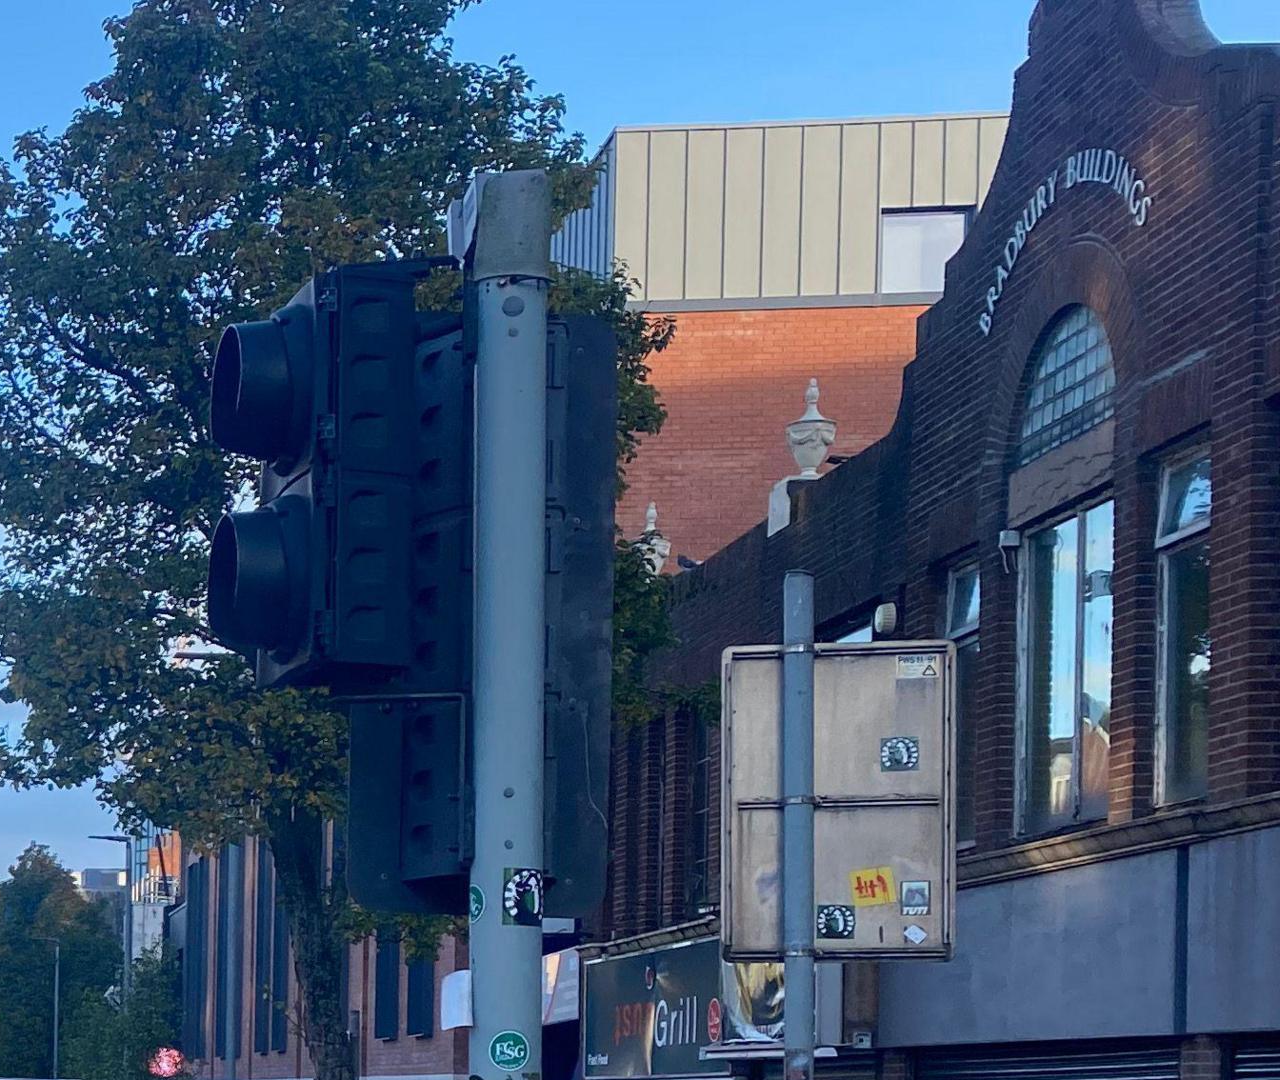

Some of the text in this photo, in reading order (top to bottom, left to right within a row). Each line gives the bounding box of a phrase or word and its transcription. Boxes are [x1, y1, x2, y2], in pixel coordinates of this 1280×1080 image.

[978, 148, 1154, 337] BRADBURY BUILDINGS
[655, 995, 697, 1047] Grill
